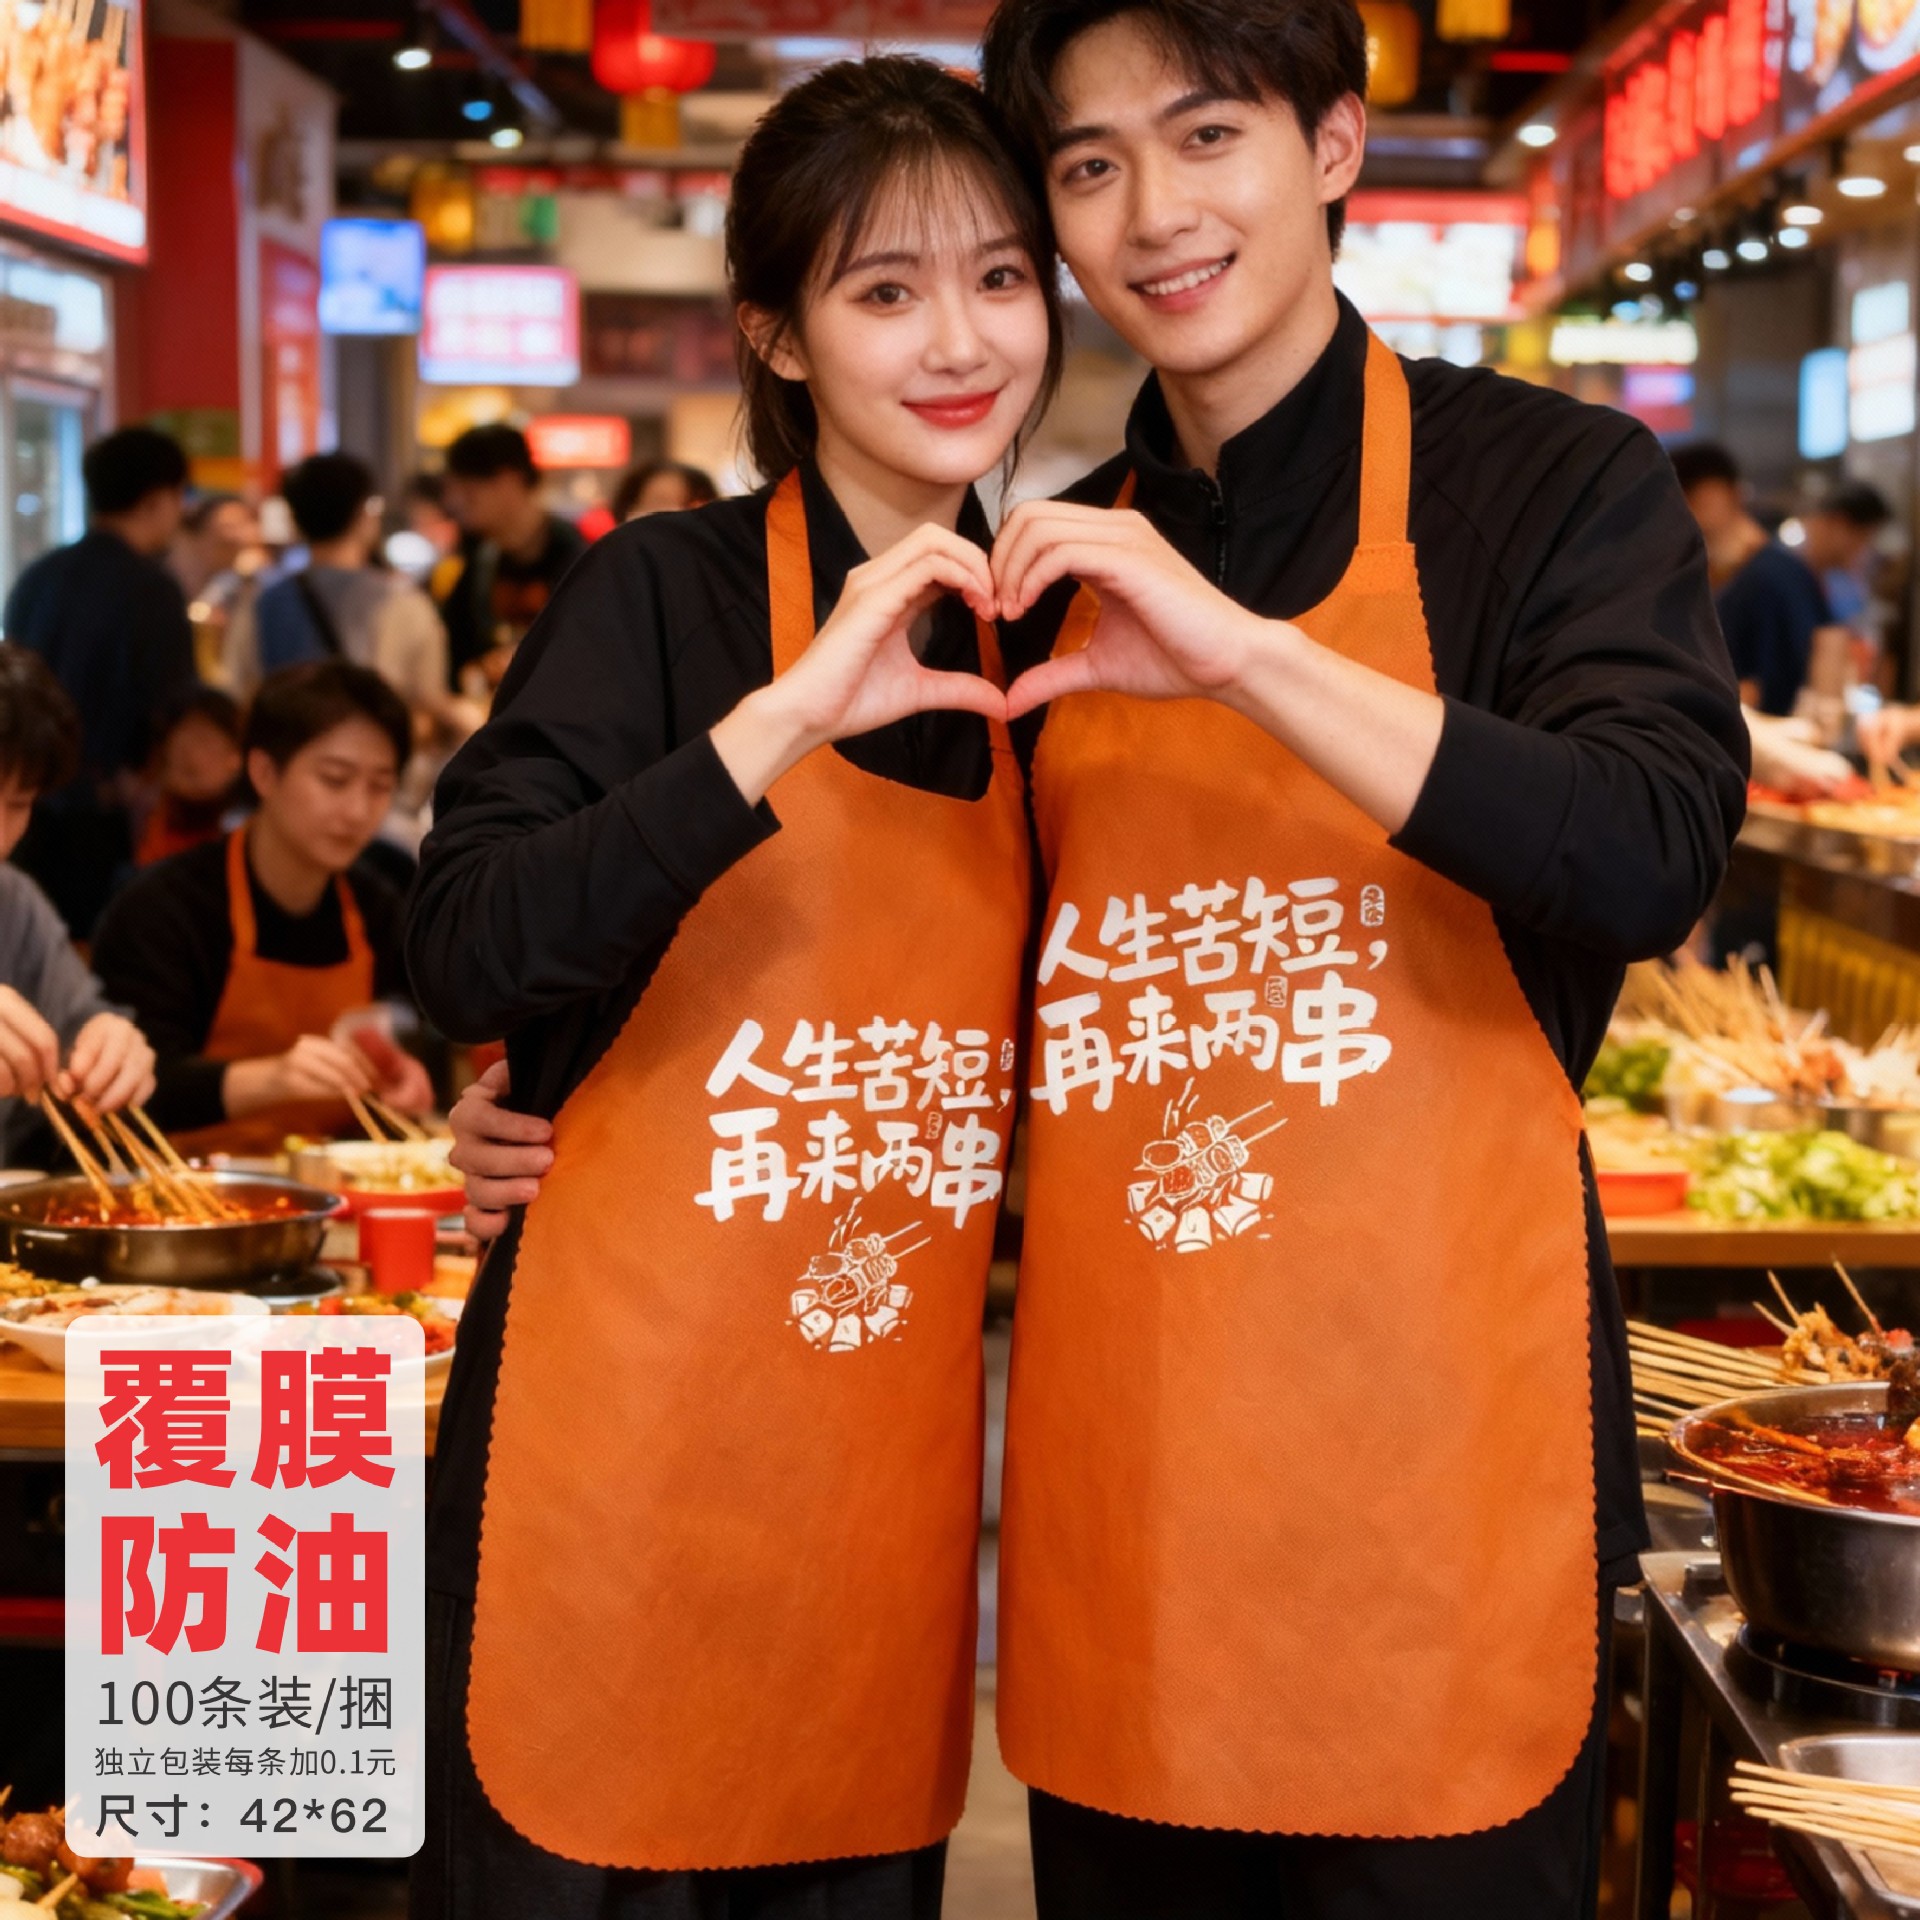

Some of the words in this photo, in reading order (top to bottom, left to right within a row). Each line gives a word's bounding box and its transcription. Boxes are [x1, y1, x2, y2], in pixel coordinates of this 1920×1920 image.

[1038, 877, 1387, 985] 人生苦短，
[1030, 970, 1392, 1115] 再来两串
[694, 1107, 1002, 1229] 再来两串
